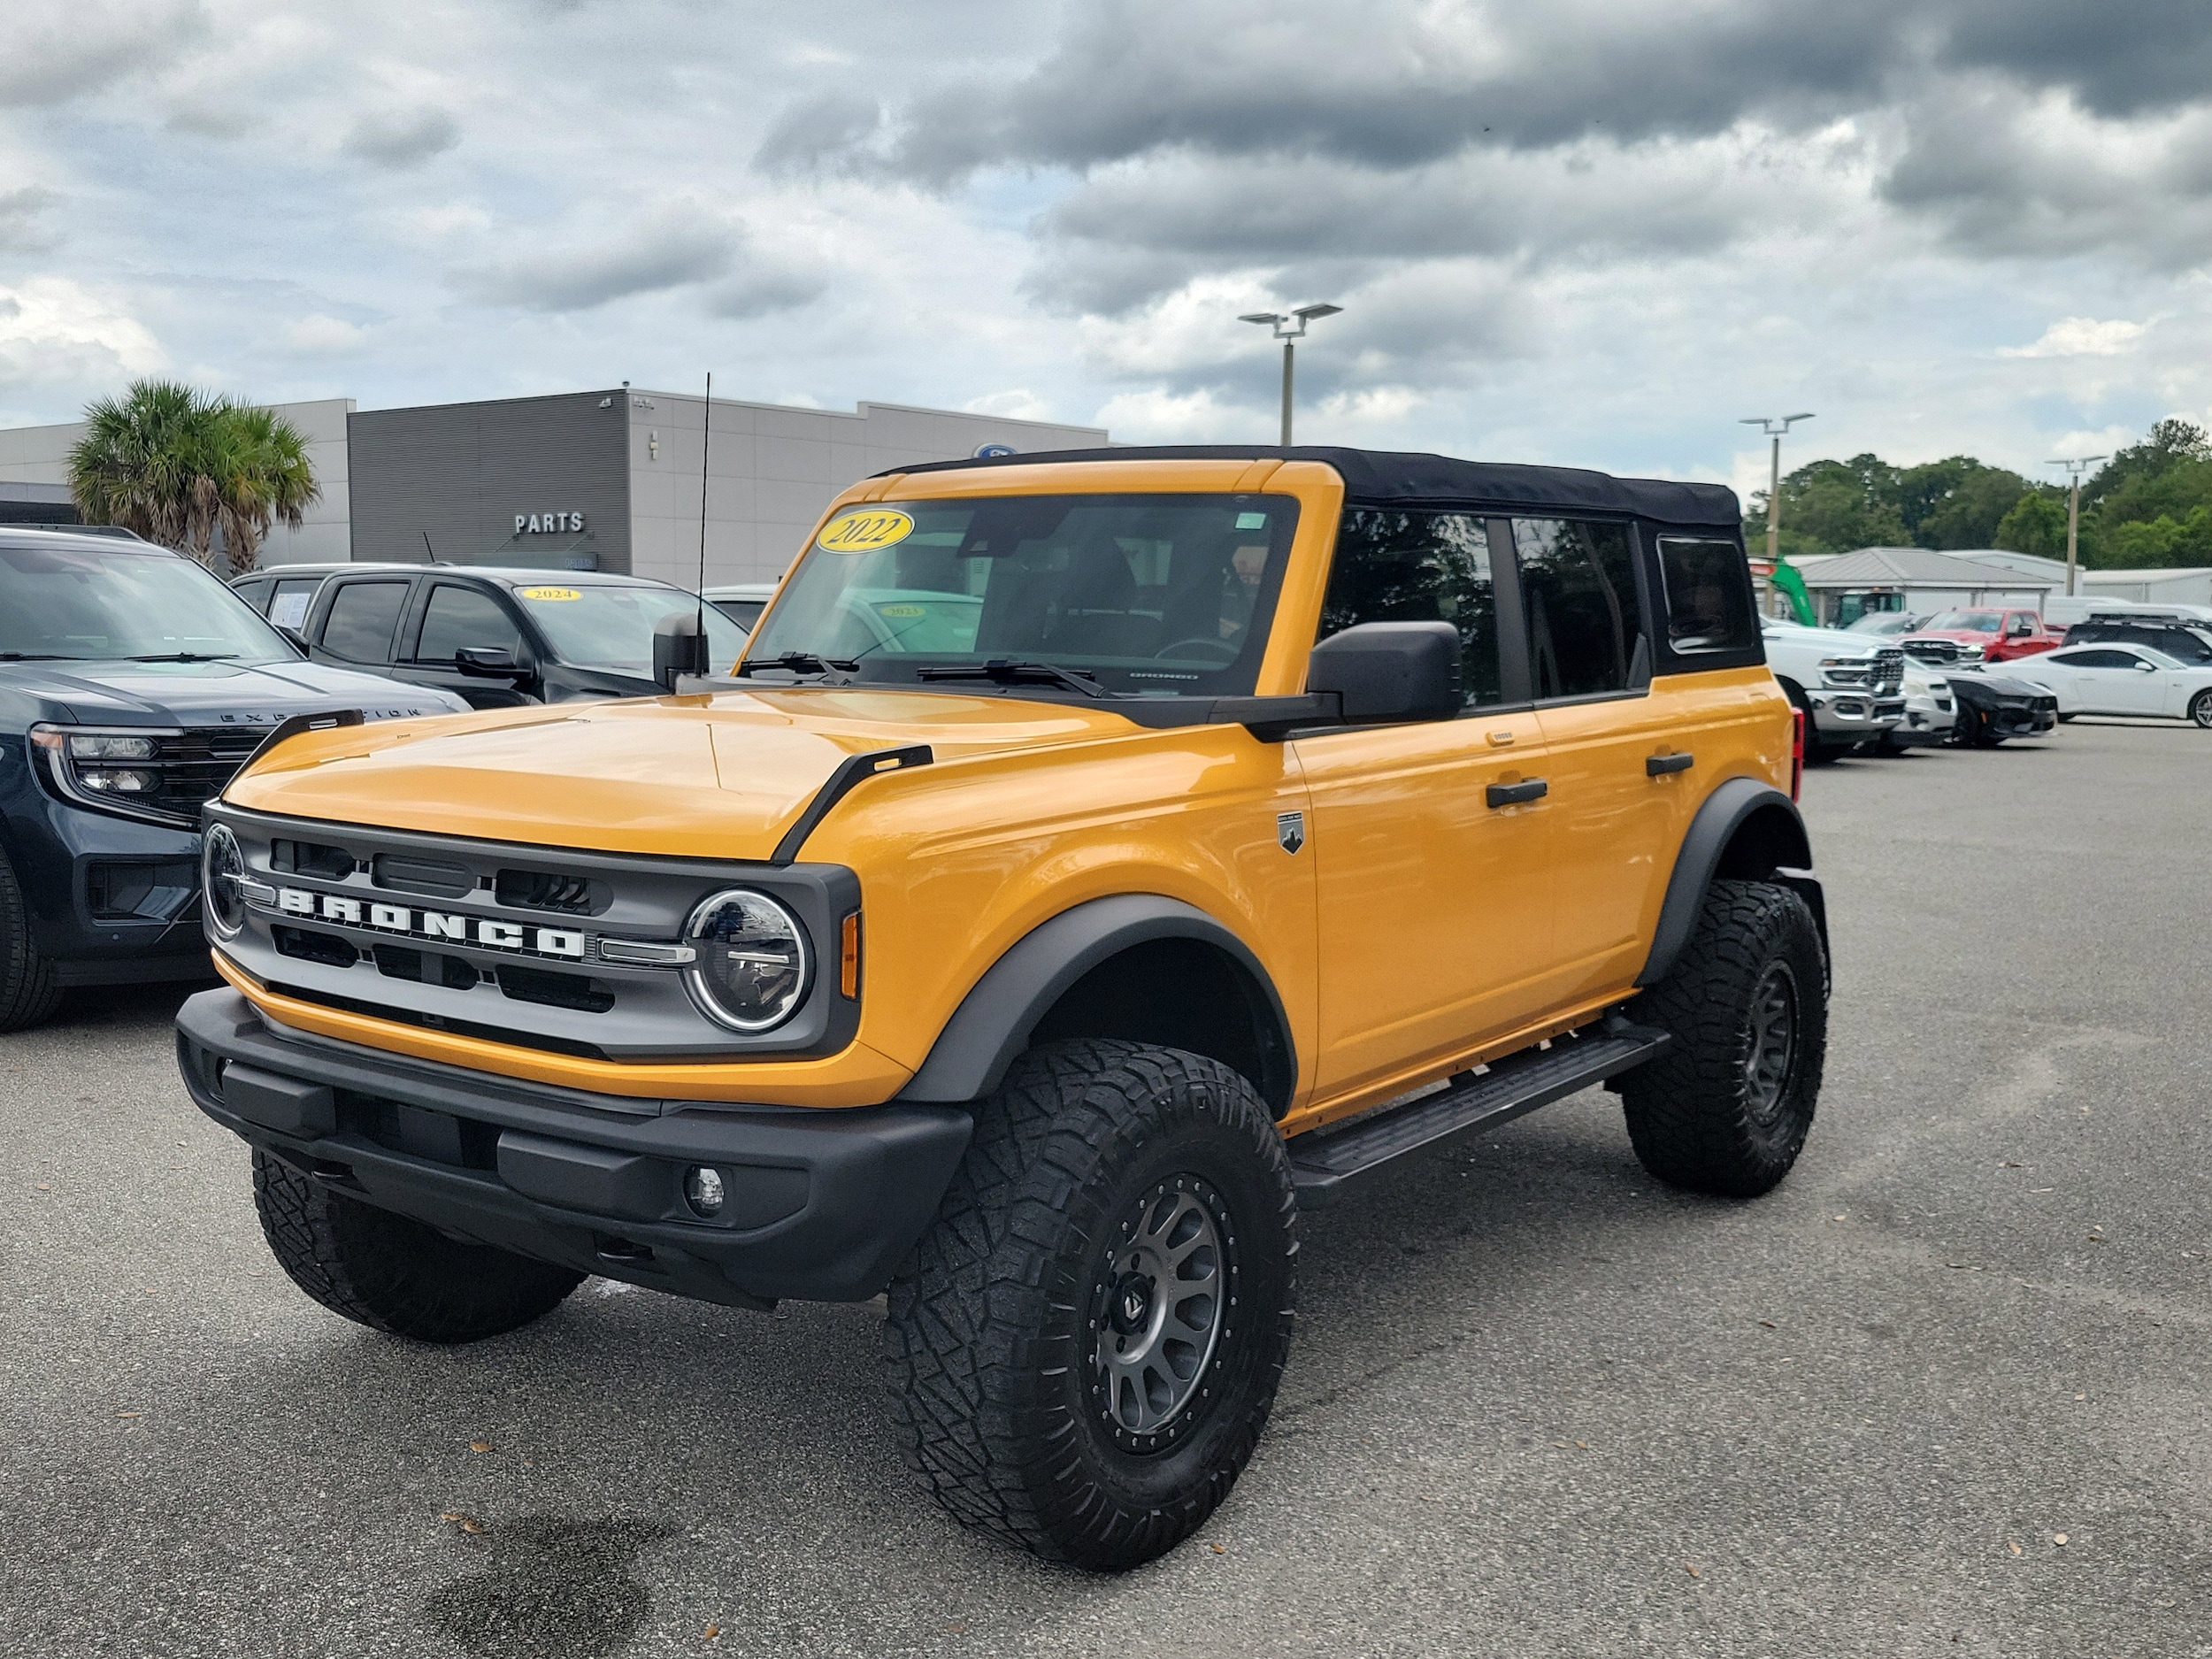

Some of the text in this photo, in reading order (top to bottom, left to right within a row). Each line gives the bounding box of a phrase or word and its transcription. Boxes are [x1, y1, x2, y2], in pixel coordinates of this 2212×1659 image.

[516, 512, 583, 534] PARTS
[826, 518, 901, 544] 2022
[534, 589, 572, 599] 2024
[280, 887, 586, 956] BRONCO
